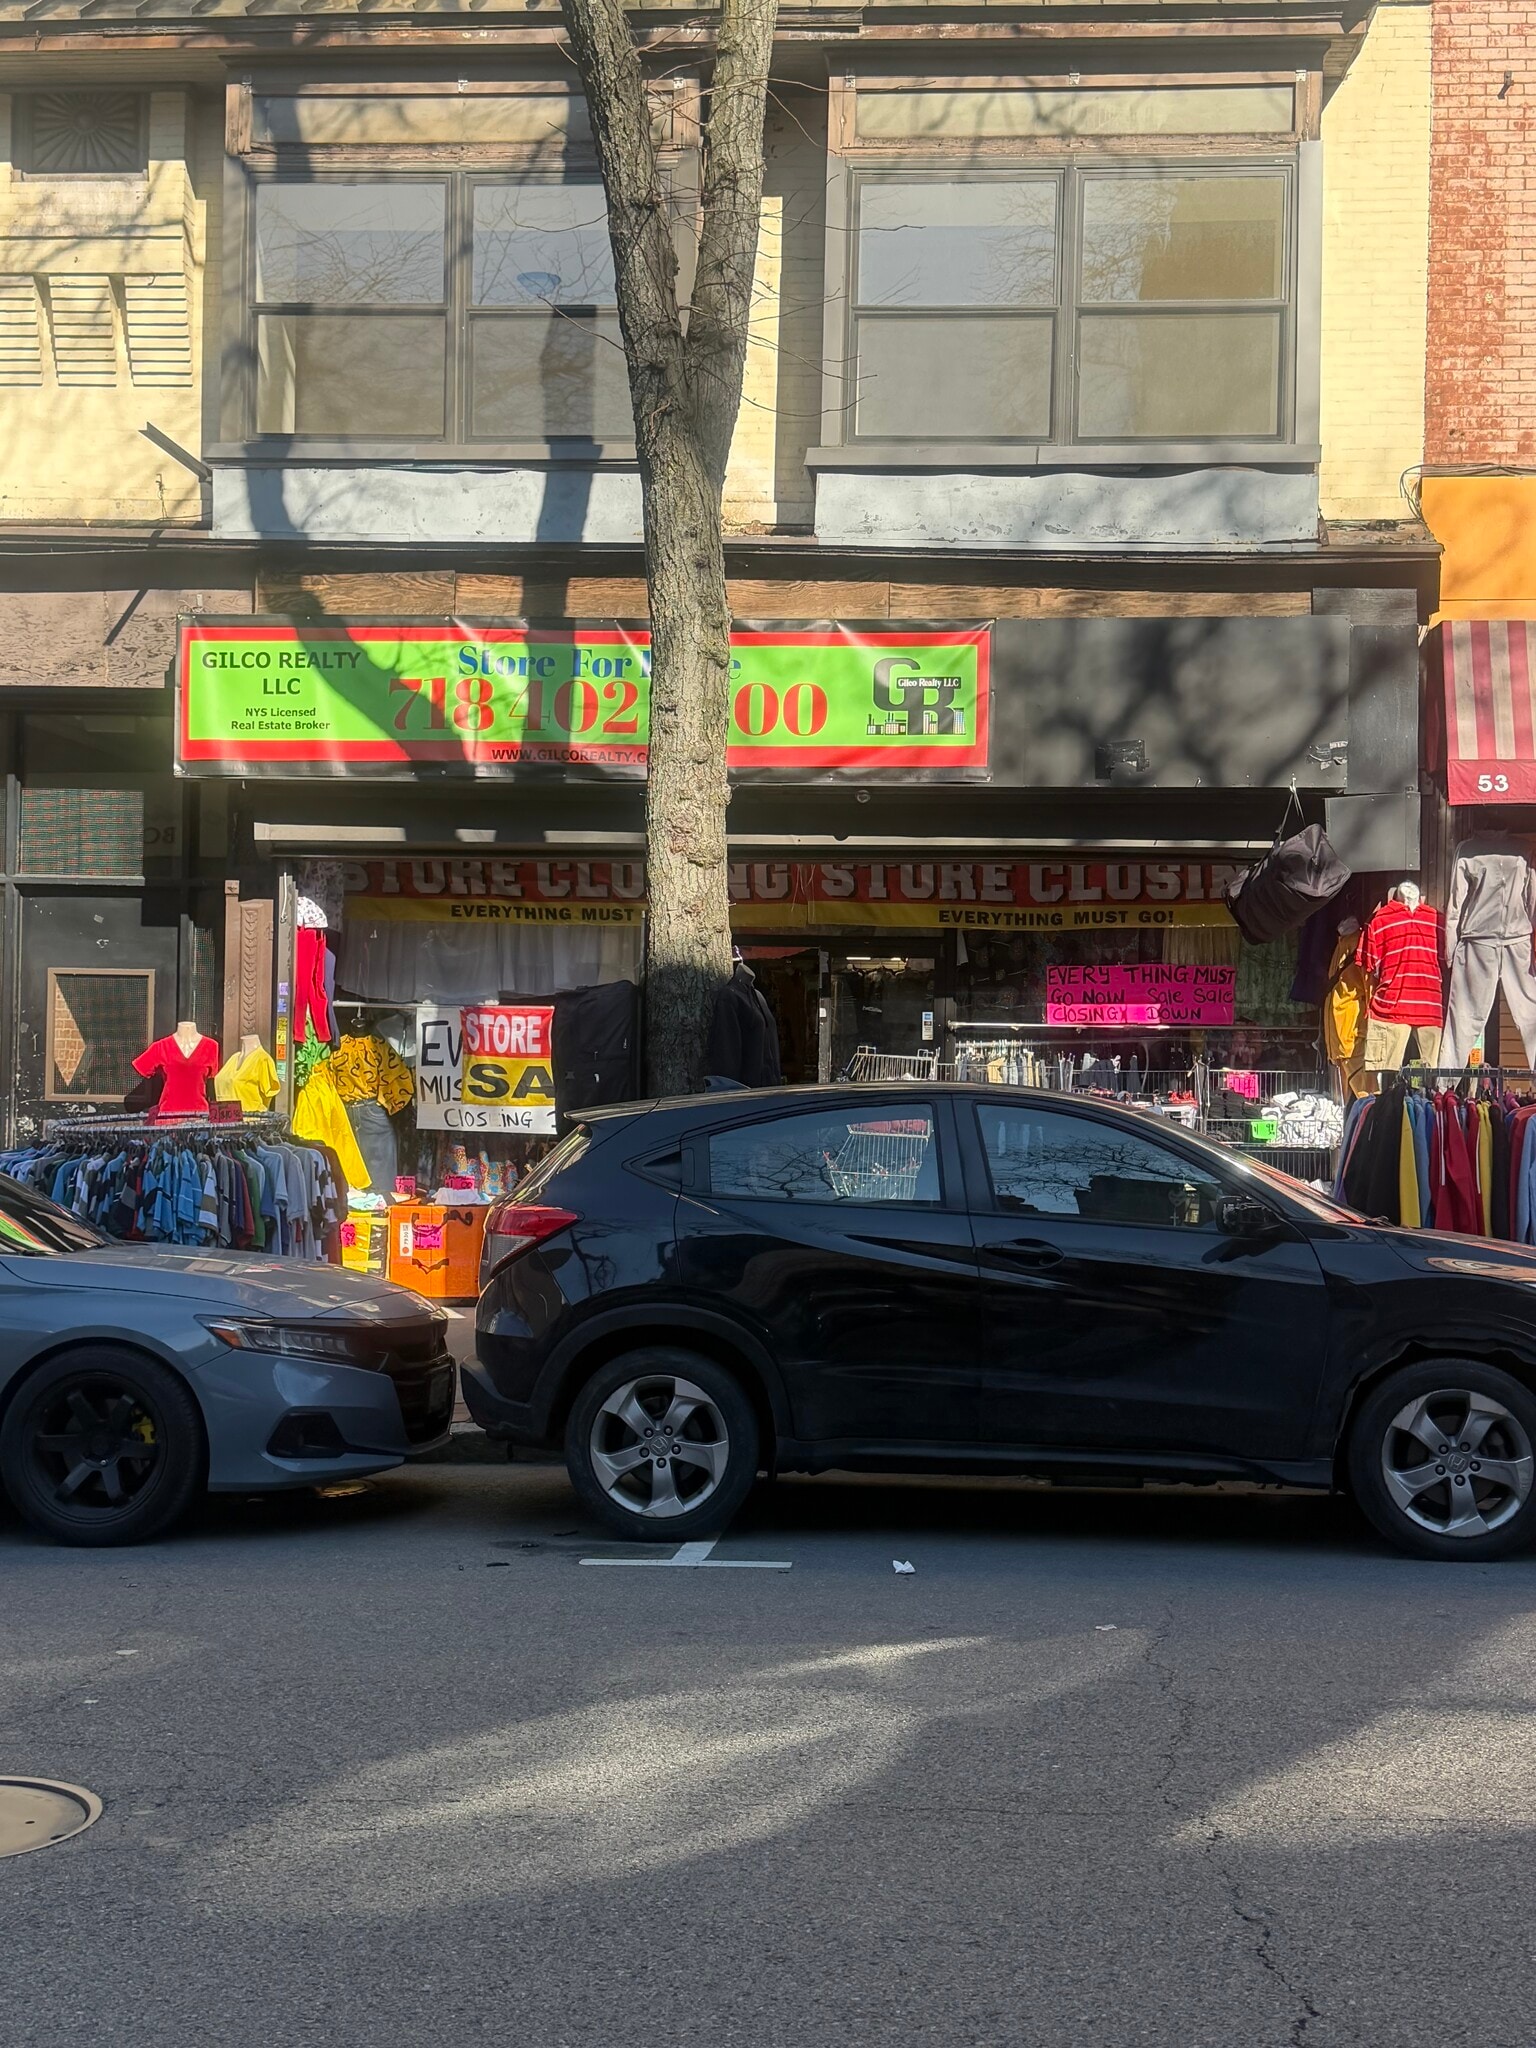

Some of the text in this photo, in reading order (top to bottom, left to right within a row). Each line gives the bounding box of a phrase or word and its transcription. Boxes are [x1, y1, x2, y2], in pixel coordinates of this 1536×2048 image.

[202, 651, 361, 669] GILCO REALTY
[458, 645, 555, 677] Store
[572, 648, 632, 679] For
[263, 678, 301, 695] LLC
[897, 678, 959, 688] Gilco Realty LLC
[245, 707, 317, 717] NYS Licensed
[388, 677, 494, 731] 718
[508, 679, 638, 734] 402
[231, 721, 331, 731] Real Estate Broker
[492, 749, 648, 763] WWW.GILCOREALTY.C
[1477, 774, 1509, 792] 53
[536, 862, 788, 899] CLONG
[820, 865, 1016, 900] STORE
[451, 905, 633, 922] EVERYTHING MUST
[938, 910, 1174, 926] EVERYTHING MUST GO!
[1048, 966, 1235, 985] EVERY THING MUST
[1051, 988, 1073, 1006] GO
[1147, 988, 1183, 1005] Sale
[1147, 1006, 1201, 1020] DOWN
[466, 1013, 542, 1053] STORE
[468, 1063, 555, 1099] SA
